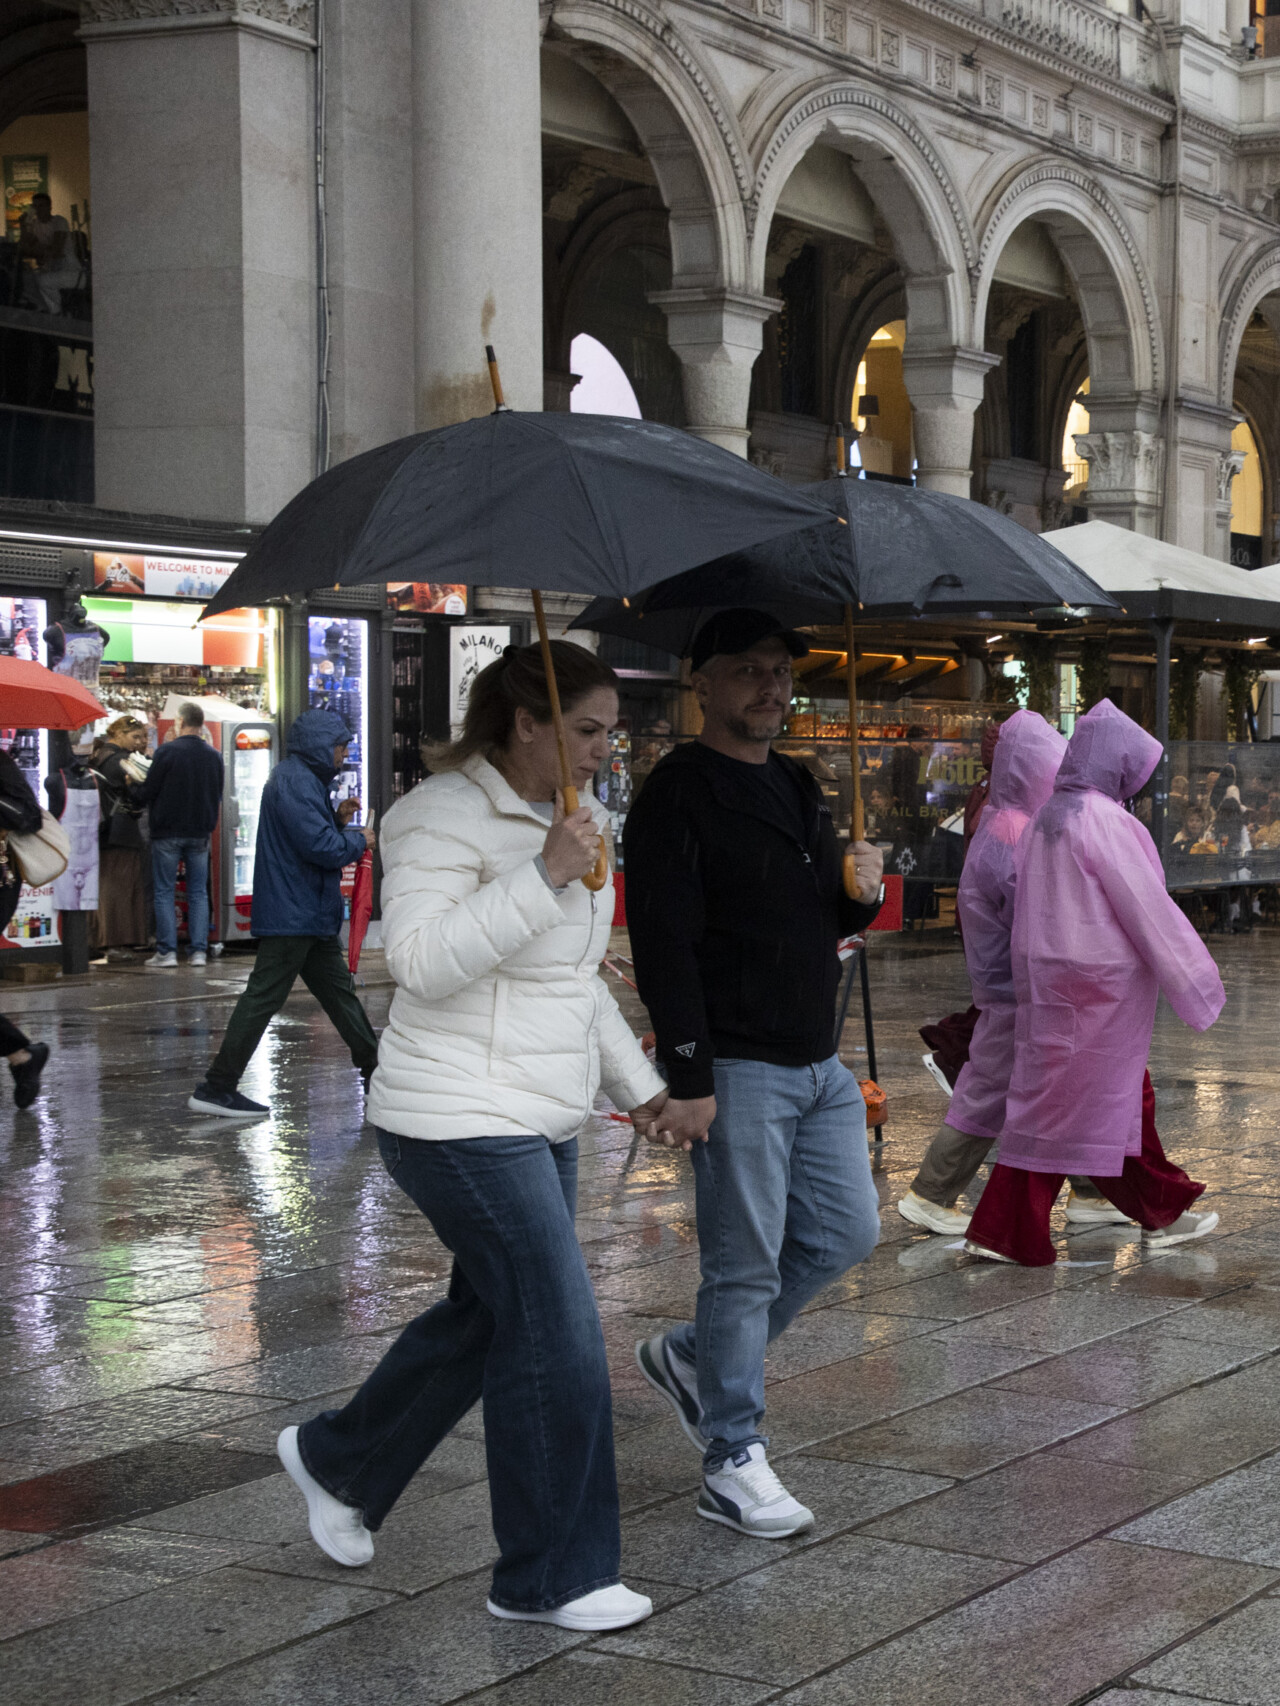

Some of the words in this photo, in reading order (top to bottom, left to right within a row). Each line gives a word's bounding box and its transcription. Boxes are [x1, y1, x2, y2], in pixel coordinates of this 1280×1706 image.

[146, 562, 198, 573] WELCOME
[200, 565, 213, 575] TO
[215, 566, 234, 577] MIL
[459, 634, 503, 655] MILANO
